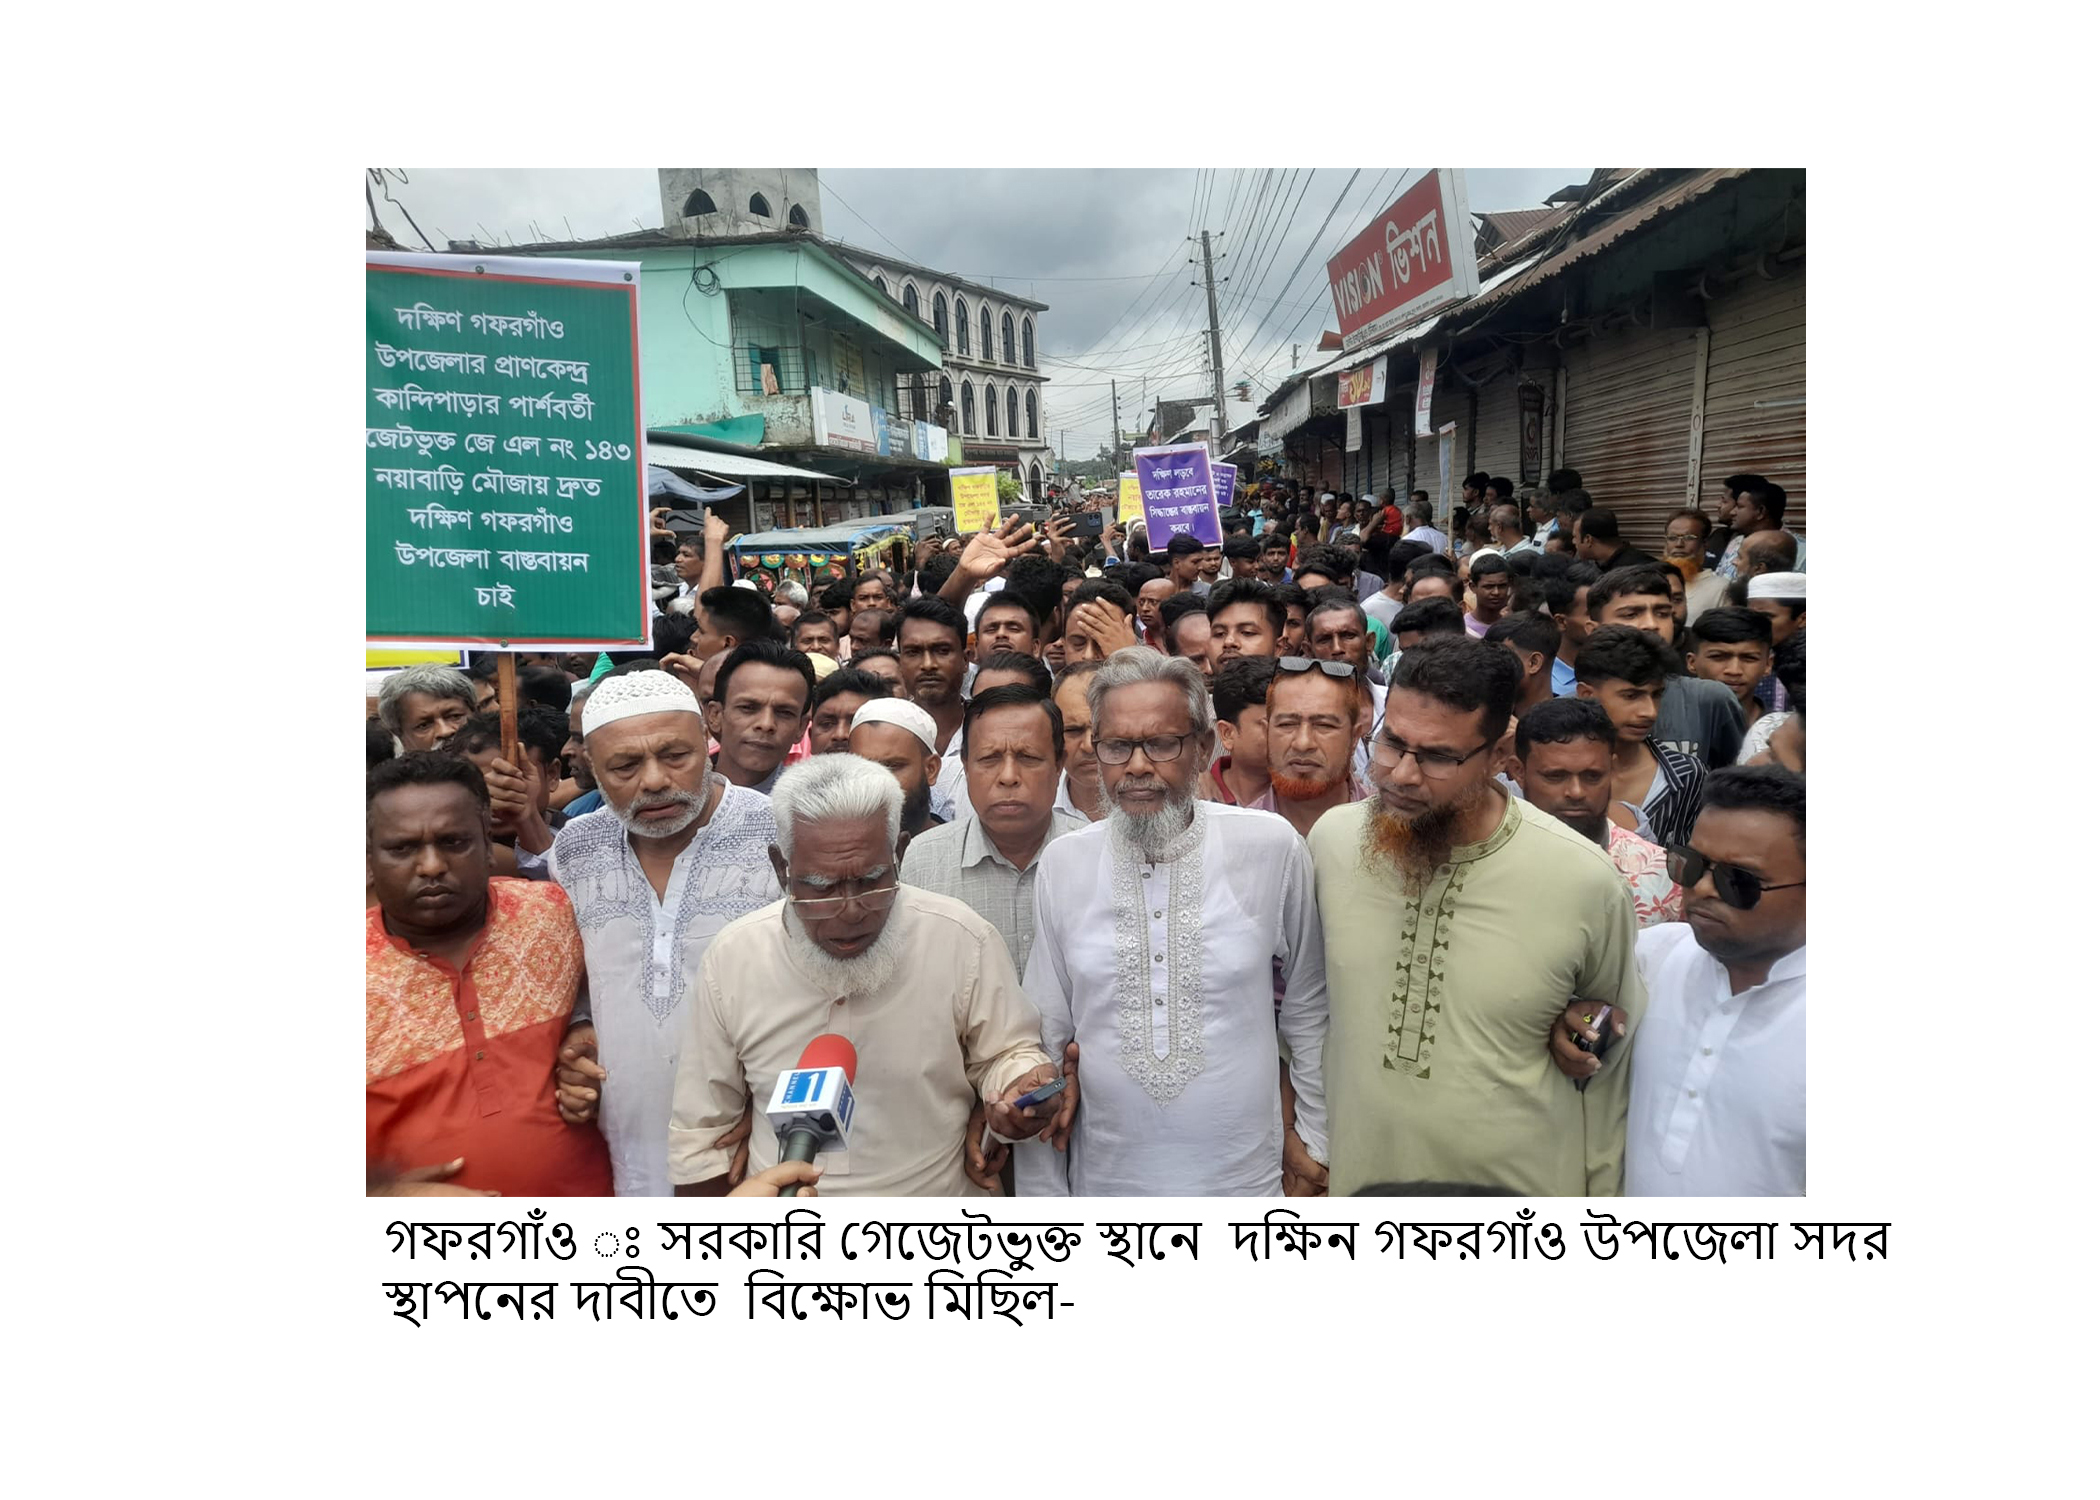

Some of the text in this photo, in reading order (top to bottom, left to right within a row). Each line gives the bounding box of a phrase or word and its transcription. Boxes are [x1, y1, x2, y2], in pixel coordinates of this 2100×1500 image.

[1385, 208, 1442, 290] ভিশন
[1334, 251, 1385, 320] VISION
[394, 302, 565, 339] দক্ষিণ গফরগাঁও
[374, 341, 590, 385] উপজেলার প্রাণকেন্দ্র
[373, 382, 501, 417] কান্দিপাড়ার
[464, 433, 497, 454] জে
[503, 436, 541, 457] এল
[547, 437, 577, 460] নং
[584, 440, 631, 461] ১৪৩
[373, 464, 603, 500] নয়াবাড়ি মৌজায় দ্রুত
[1145, 489, 1171, 501] তারেক
[1173, 485, 1207, 498] রহমানের
[406, 502, 573, 534] দক্ষিণ গফরগাঁও
[394, 540, 590, 572] উপজেলা বাস্তবায়ন
[474, 582, 516, 609] চাই
